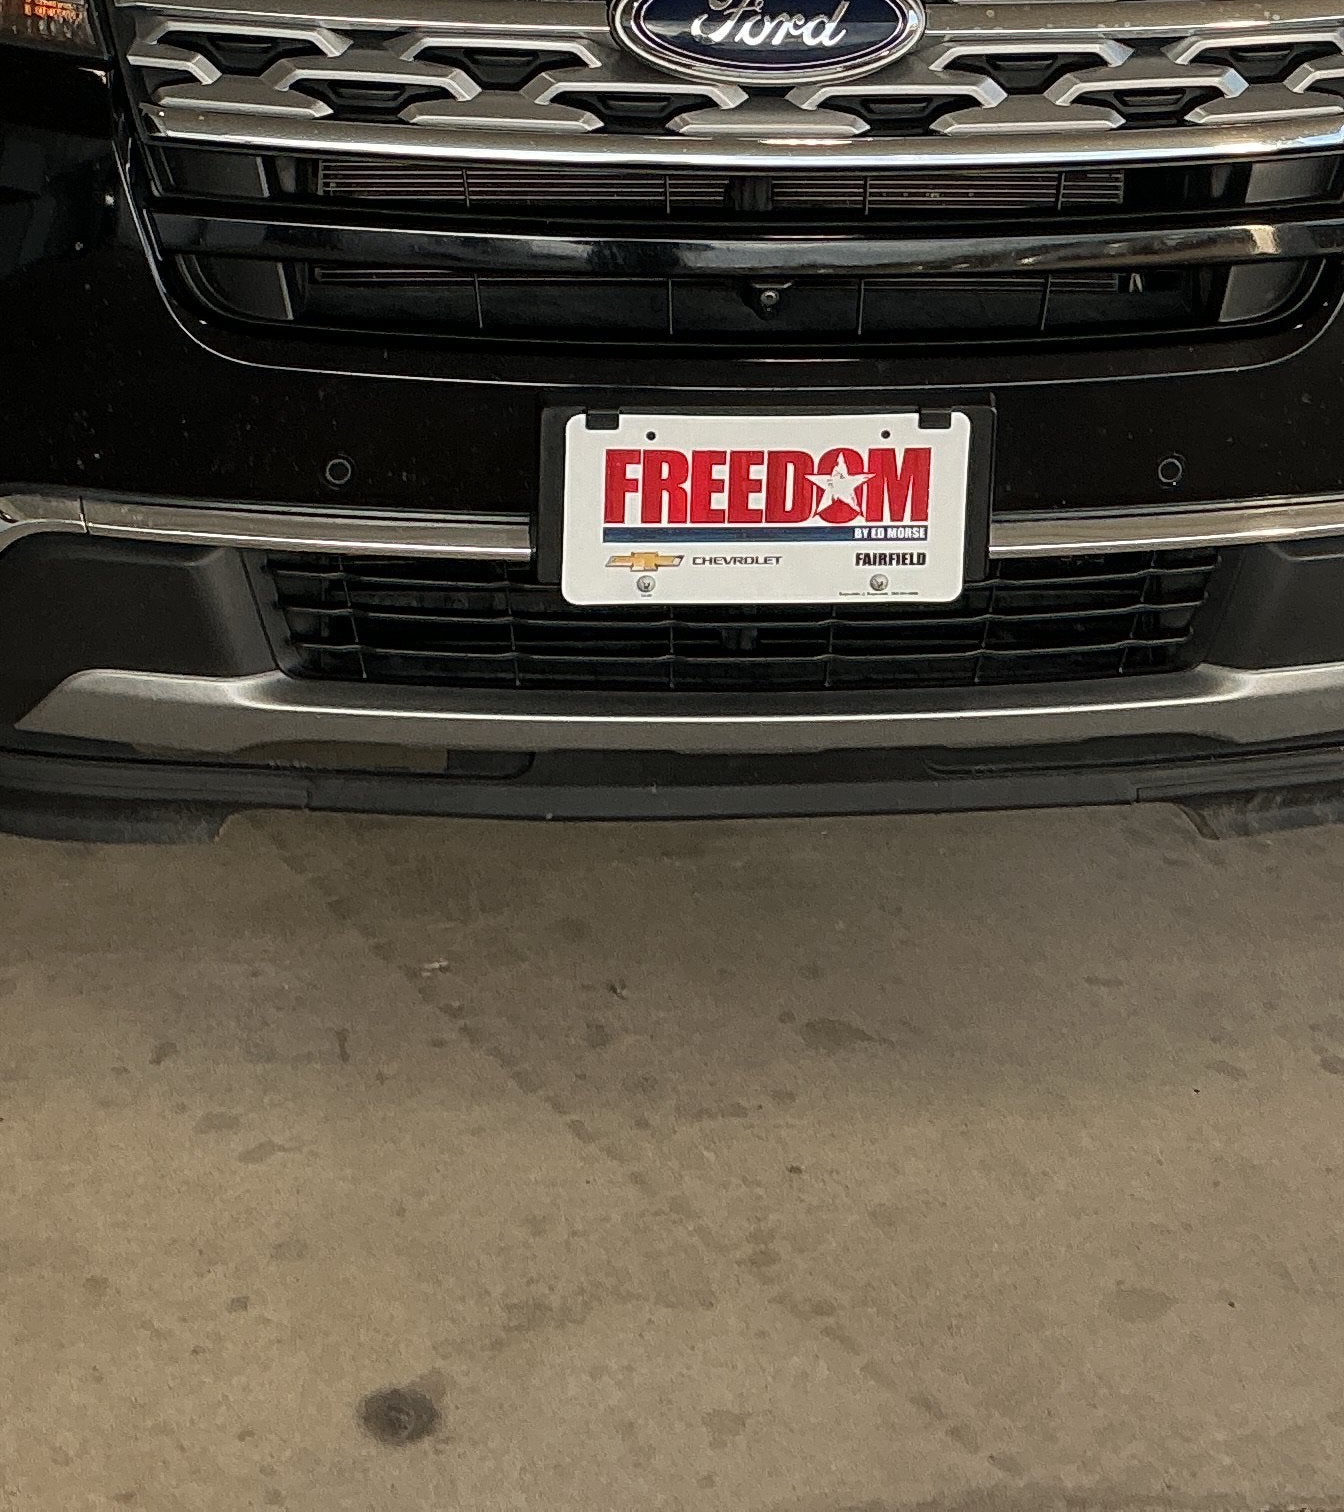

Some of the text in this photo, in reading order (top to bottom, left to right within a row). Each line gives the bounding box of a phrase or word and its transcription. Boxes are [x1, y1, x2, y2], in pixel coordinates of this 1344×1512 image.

[603, 446, 932, 525] FREEDOM
[854, 527, 926, 539] BY ED MORSE
[691, 555, 783, 566] CHEVROLET
[855, 552, 927, 566] FAIRFIELD
